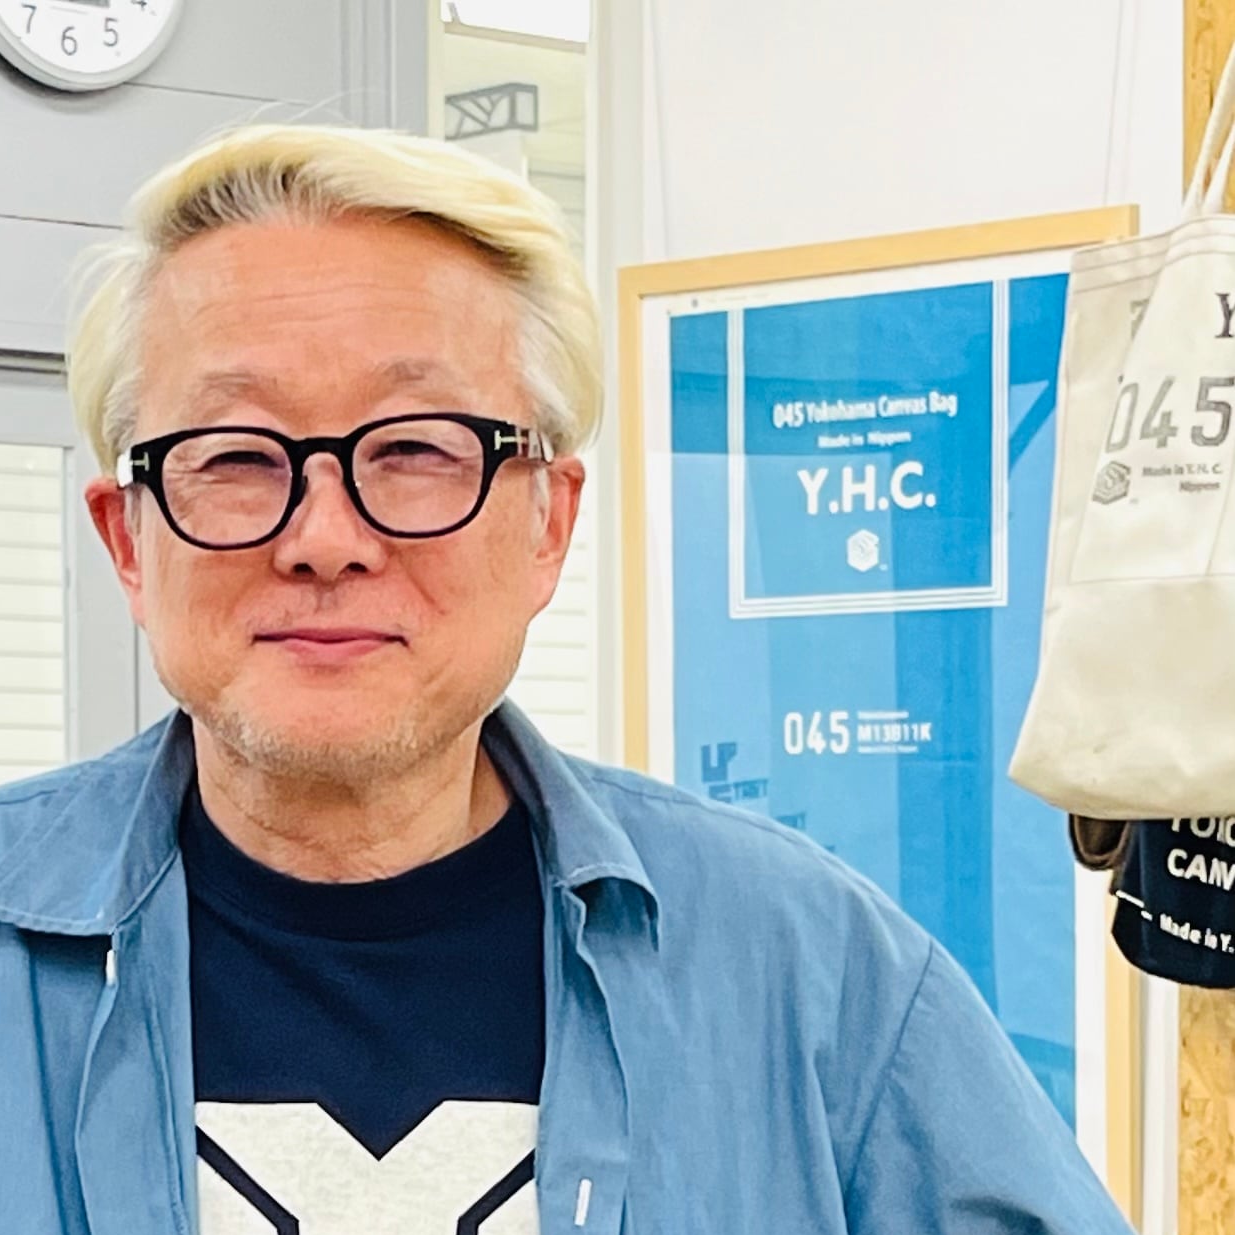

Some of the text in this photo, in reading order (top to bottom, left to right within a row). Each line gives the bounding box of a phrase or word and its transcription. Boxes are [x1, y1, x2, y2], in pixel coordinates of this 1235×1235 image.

[21, 4, 37, 34] 7
[103, 17, 119, 47] 5
[61, 26, 78, 56] 6
[773, 401, 805, 429] 045
[929, 390, 958, 418] Bag
[797, 460, 937, 516] Y.H.C.
[783, 711, 850, 755] 045
[1160, 913, 1202, 945] Made
